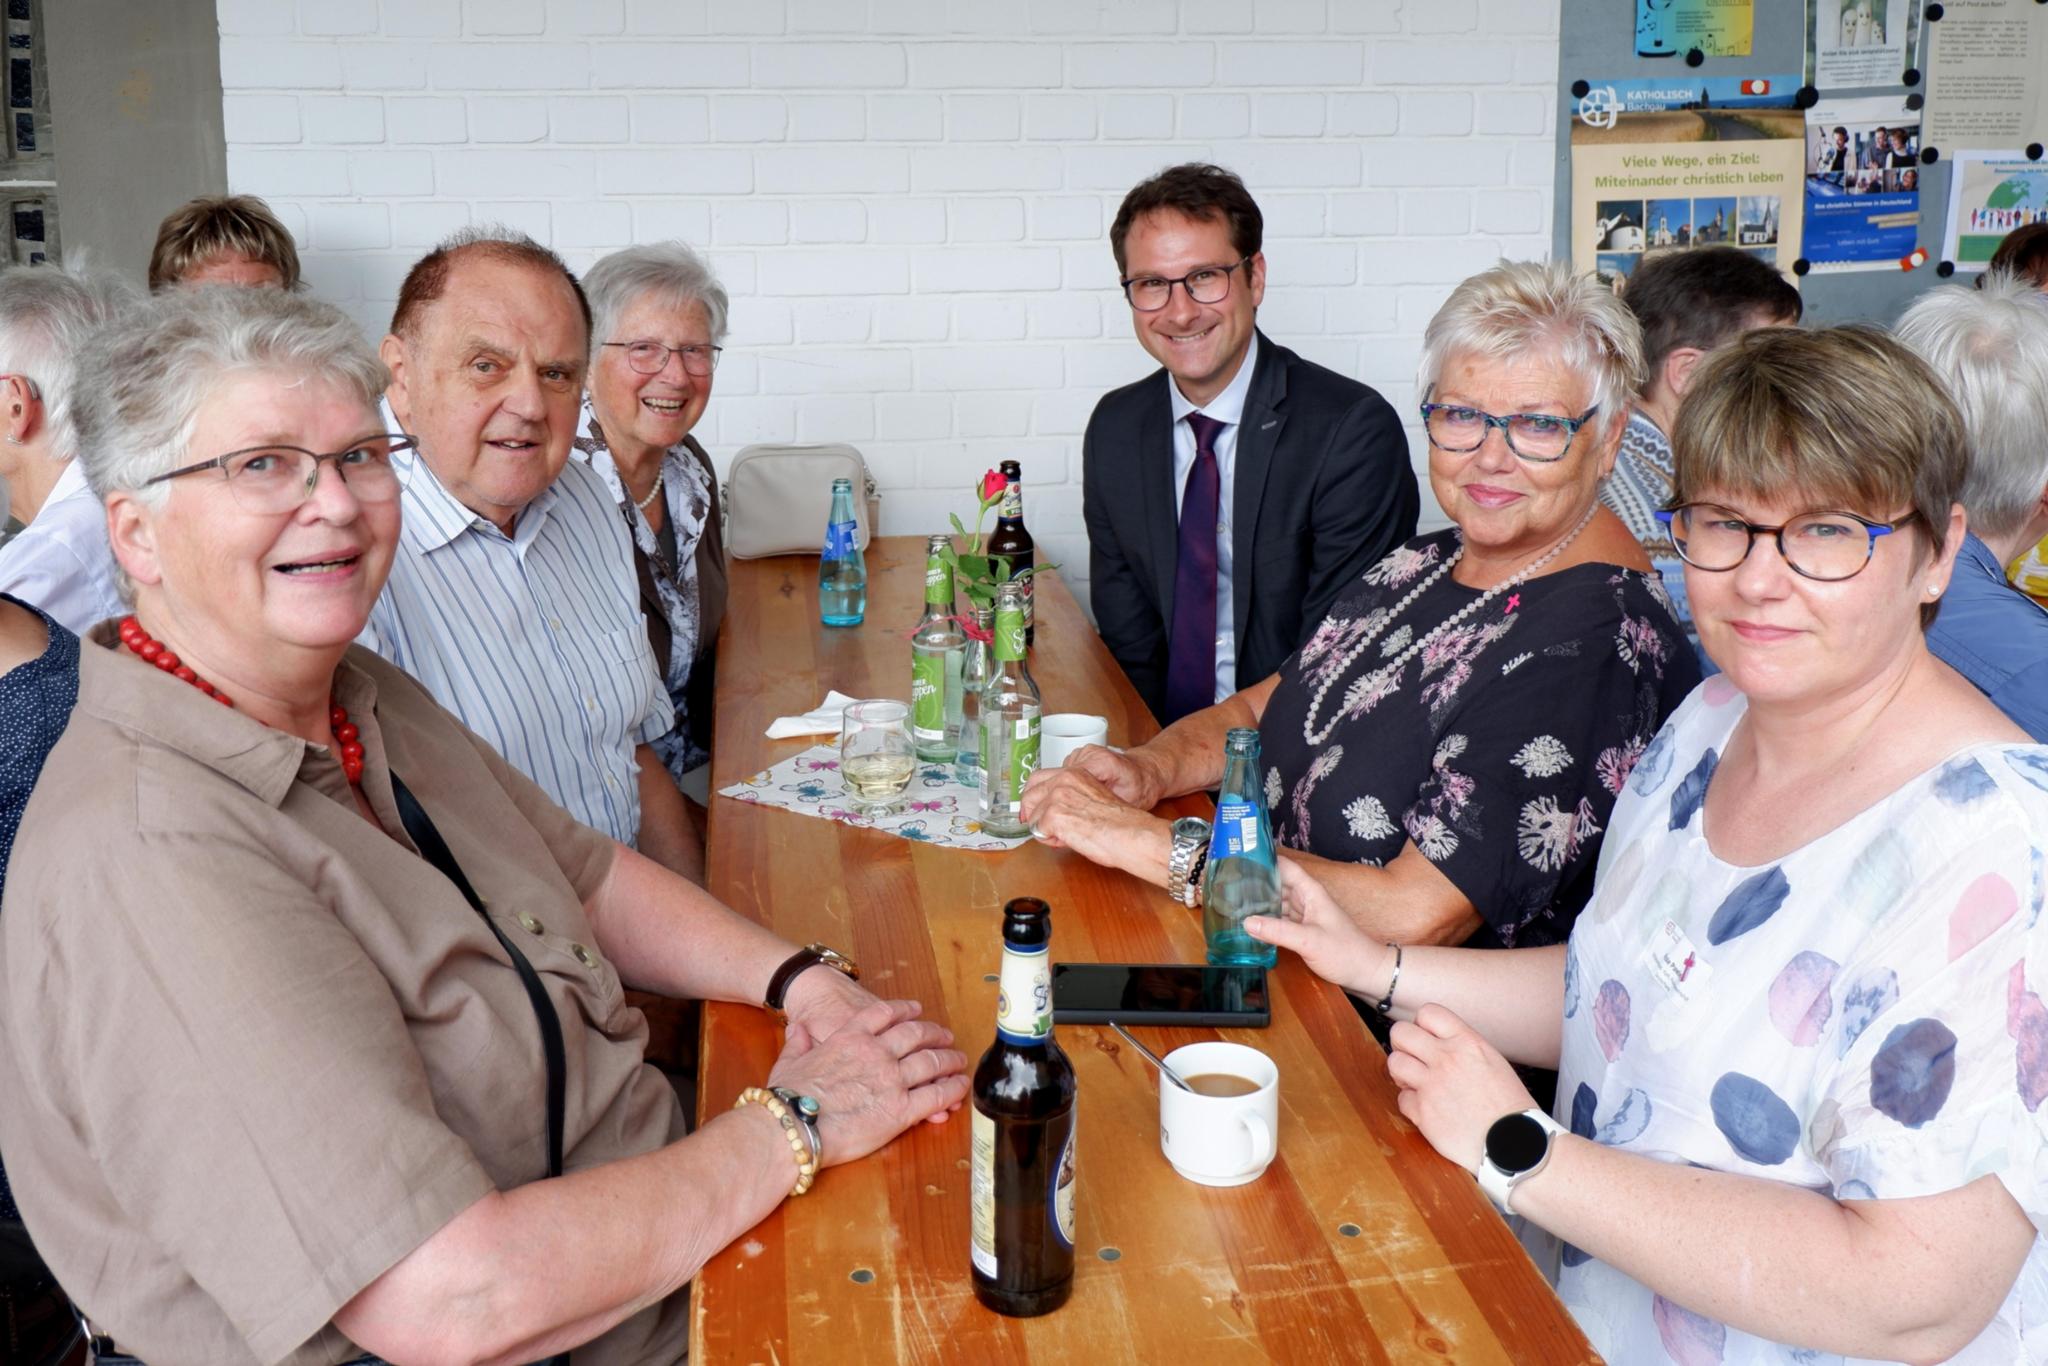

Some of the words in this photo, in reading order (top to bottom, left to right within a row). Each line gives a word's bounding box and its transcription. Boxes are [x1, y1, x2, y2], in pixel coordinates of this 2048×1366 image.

[1627, 89, 1693, 101] KATHOLISCH
[1627, 102, 1666, 113] Bachgau
[1622, 155, 1657, 168] Viele
[1661, 154, 1703, 169] Wege,
[1707, 152, 1726, 165] ein
[1730, 151, 1760, 165] Ziel:
[1595, 174, 1678, 189] Miteinander
[1683, 172, 1744, 186] christlich
[1748, 171, 1784, 184] leben
